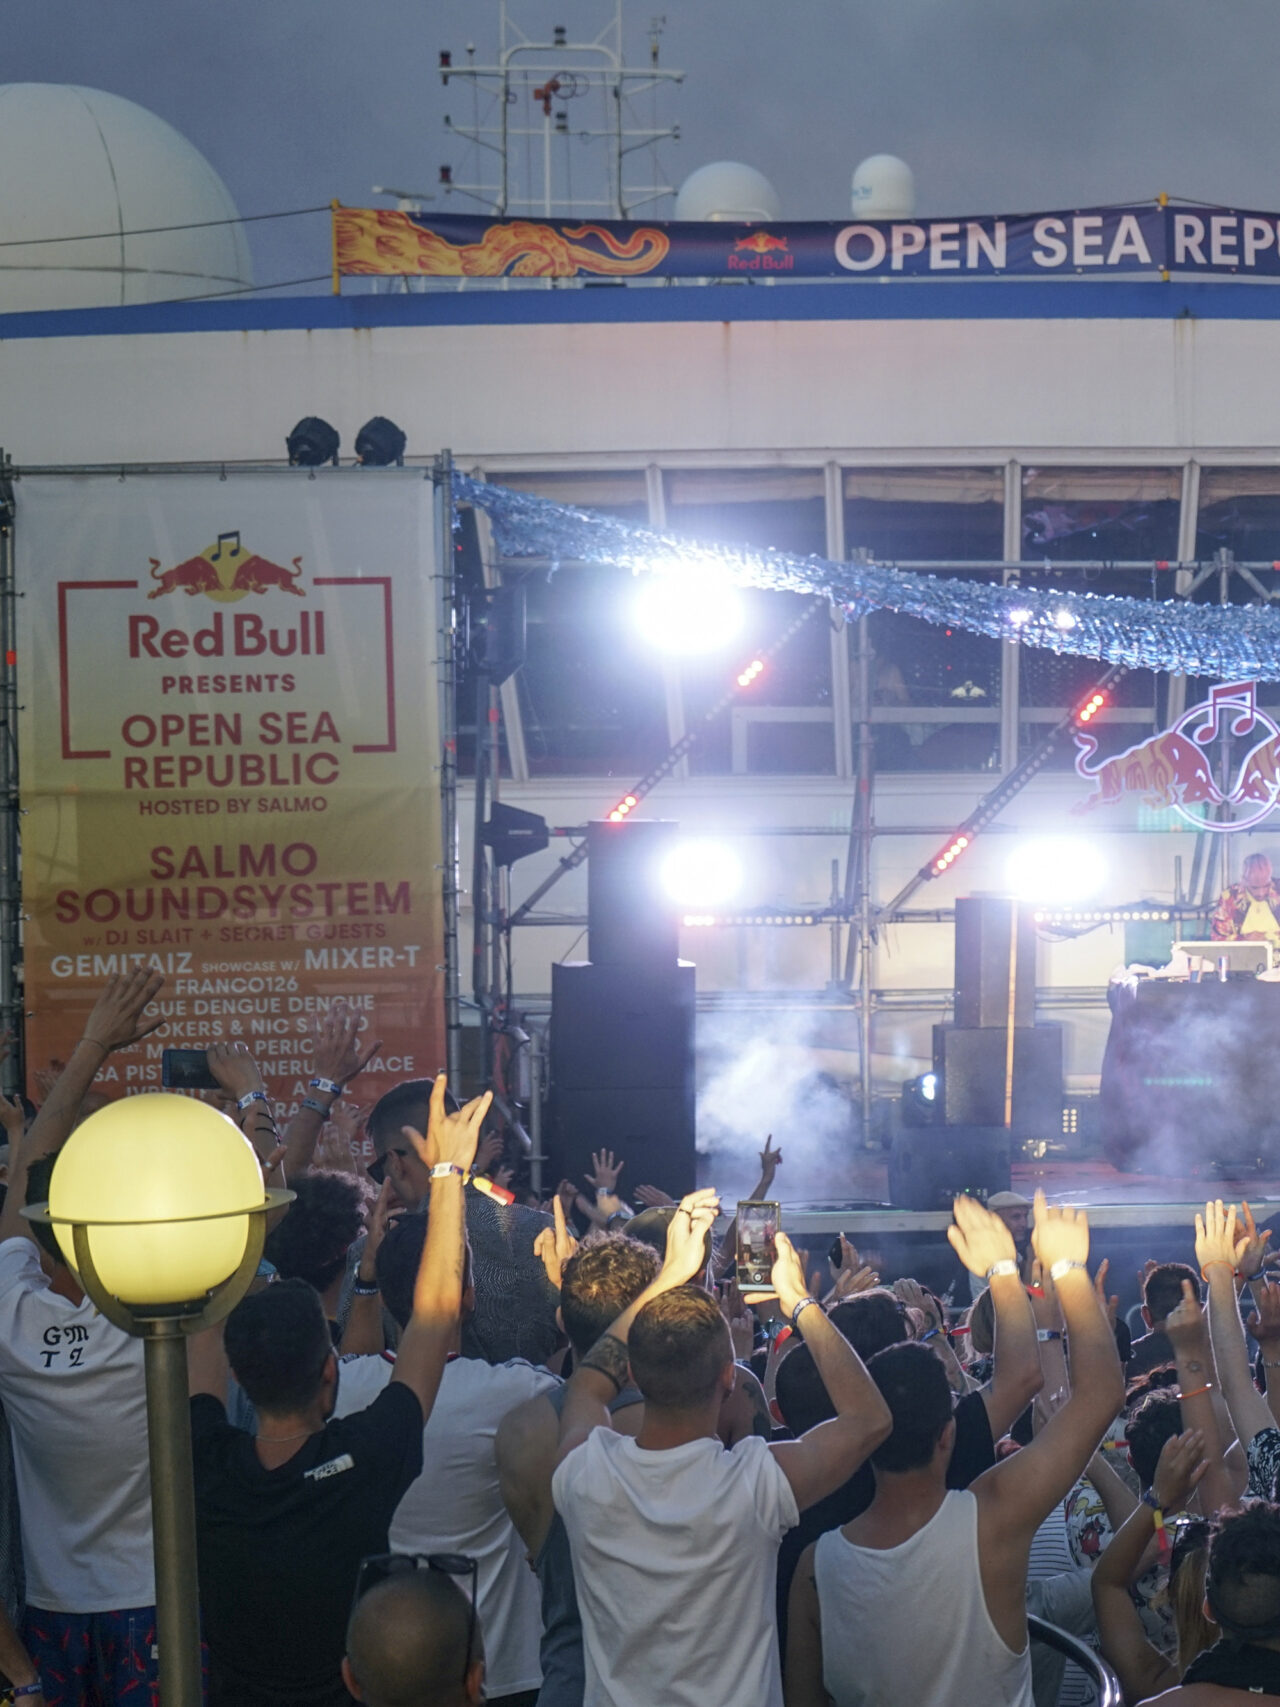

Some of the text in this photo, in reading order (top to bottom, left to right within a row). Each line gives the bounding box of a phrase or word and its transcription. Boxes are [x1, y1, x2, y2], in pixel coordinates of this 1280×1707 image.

[834, 220, 1006, 272] OPEN
[1032, 214, 1151, 269] SEA
[728, 252, 794, 270] Red Bull
[128, 611, 325, 658] Red Bull
[162, 674, 296, 694] PRESENTS
[121, 711, 341, 748] OPEN SEA
[124, 752, 340, 789] REPUBLIC
[140, 797, 327, 816] HOSTED BY SALMO
[150, 842, 318, 880] SALMO
[55, 882, 412, 924] SOUNDSYSTEM
[105, 930, 128, 945] DJ
[136, 928, 193, 945] SLAIT
[220, 924, 299, 943] SECRET
[305, 923, 386, 941] GUESTS
[50, 952, 193, 978] GEMITAIZ
[202, 960, 276, 973] SHOWCASE
[305, 946, 420, 970] MIXER-T
[176, 976, 299, 995] FRANCO126
[143, 1001, 186, 1017] GUE
[194, 998, 281, 1015] DENGUE
[231, 1020, 243, 1036] &
[251, 1018, 288, 1036] NIC
